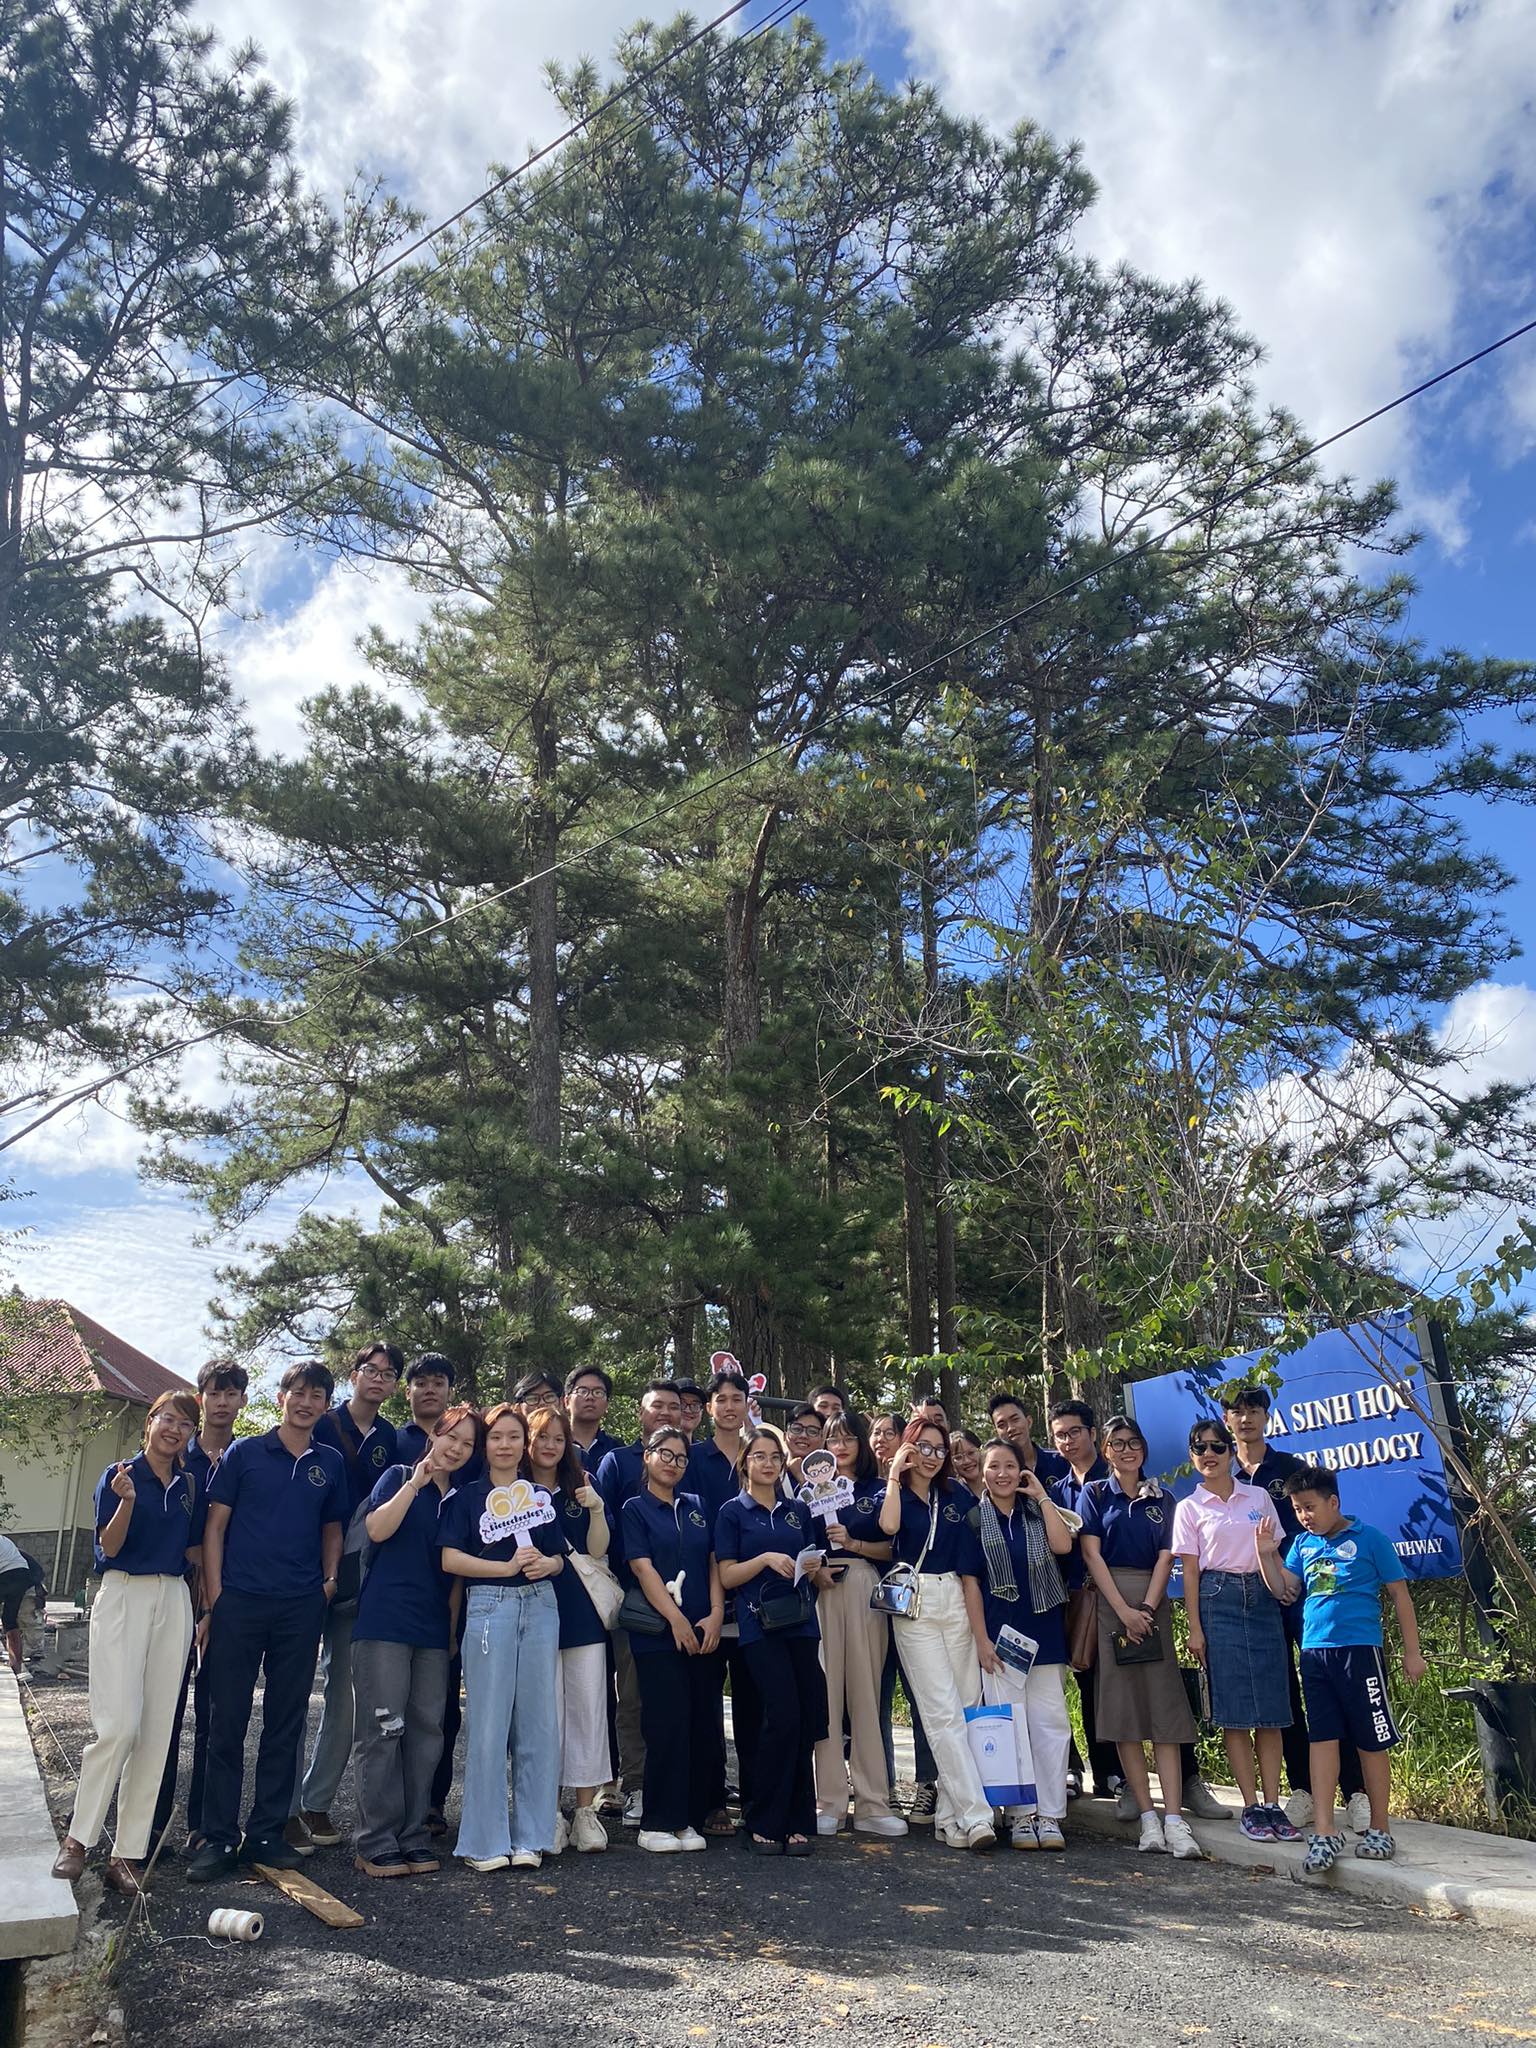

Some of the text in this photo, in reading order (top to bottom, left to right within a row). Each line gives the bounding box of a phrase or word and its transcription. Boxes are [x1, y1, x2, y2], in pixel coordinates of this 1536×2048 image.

[1291, 1393, 1353, 1431] SINH
[1355, 1379, 1411, 1420] HỌC
[1323, 1431, 1421, 1471] BIOLOGY
[488, 1482, 536, 1518] 62
[1372, 1709, 1391, 1742] 1969
